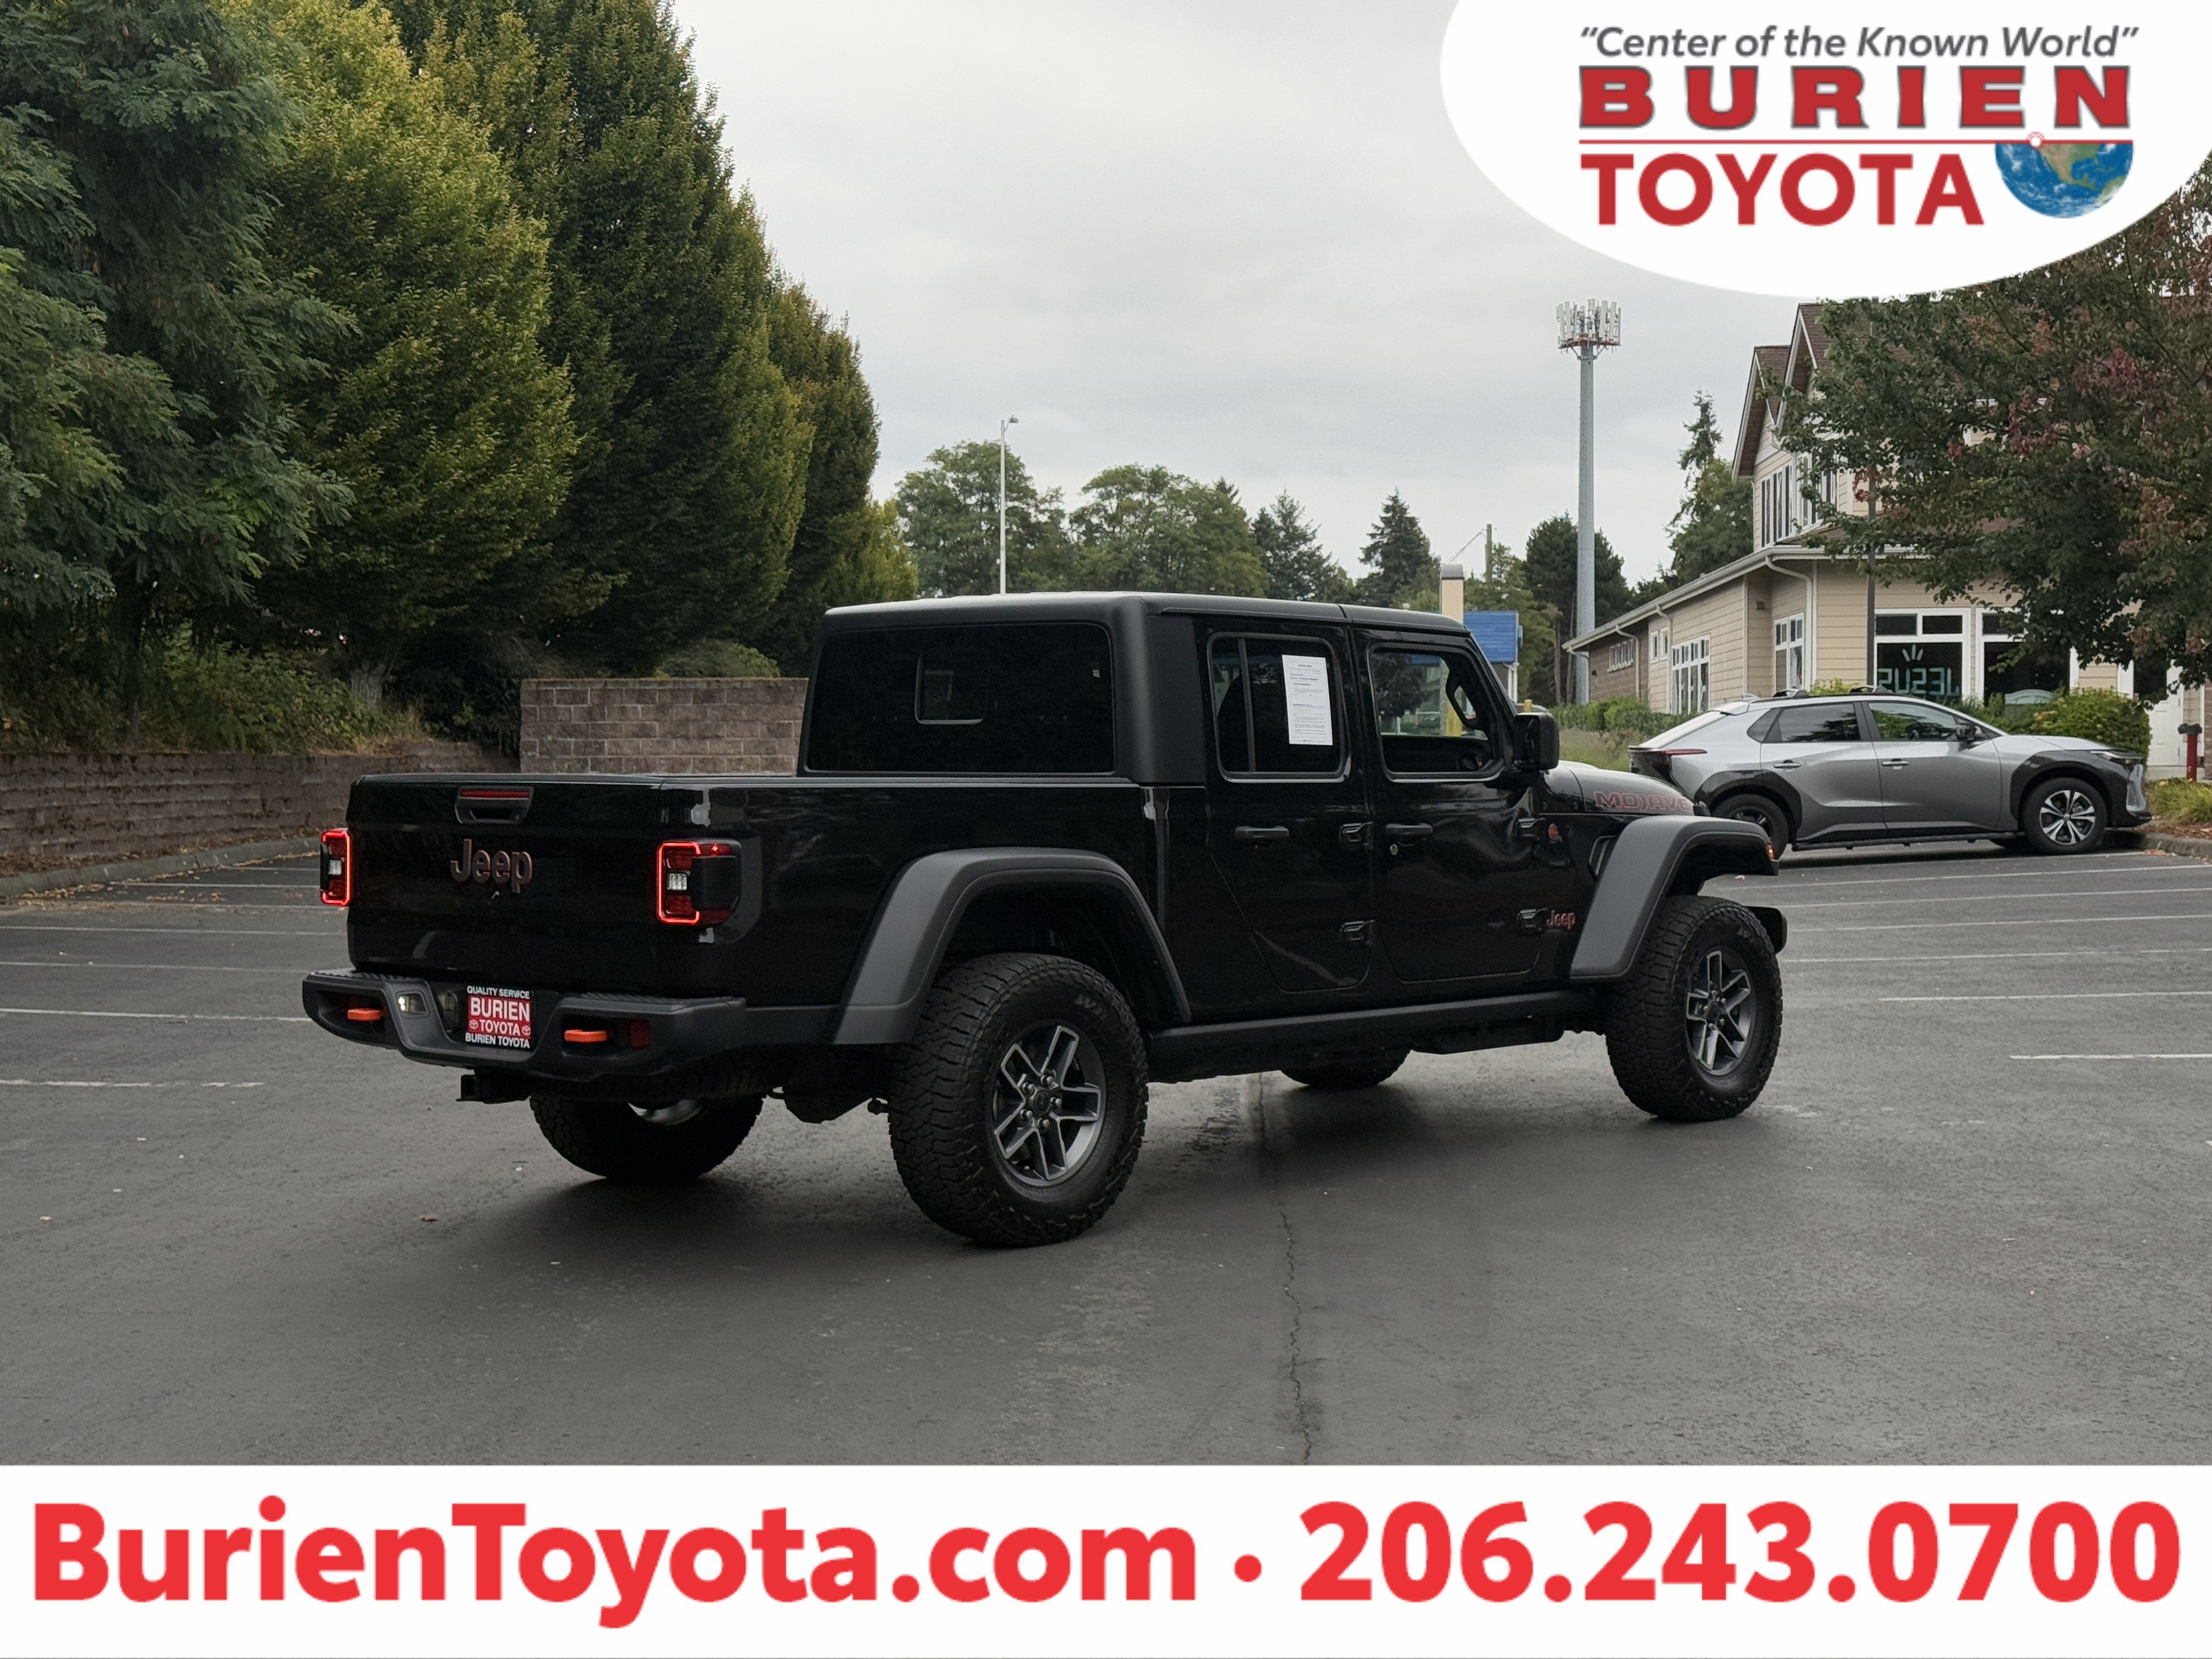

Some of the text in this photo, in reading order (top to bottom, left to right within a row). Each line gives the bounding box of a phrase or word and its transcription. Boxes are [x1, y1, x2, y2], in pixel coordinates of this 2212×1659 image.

[1593, 791, 1694, 812] MOJAVE
[450, 838, 533, 894] Jeep
[1547, 909, 1576, 930] Jeep
[467, 985, 531, 1000] QUALITY SERVICE
[470, 997, 531, 1022] BURIEN
[479, 1019, 521, 1036] TOYOTA
[465, 1032, 531, 1049] BURIEN TOYOTA
